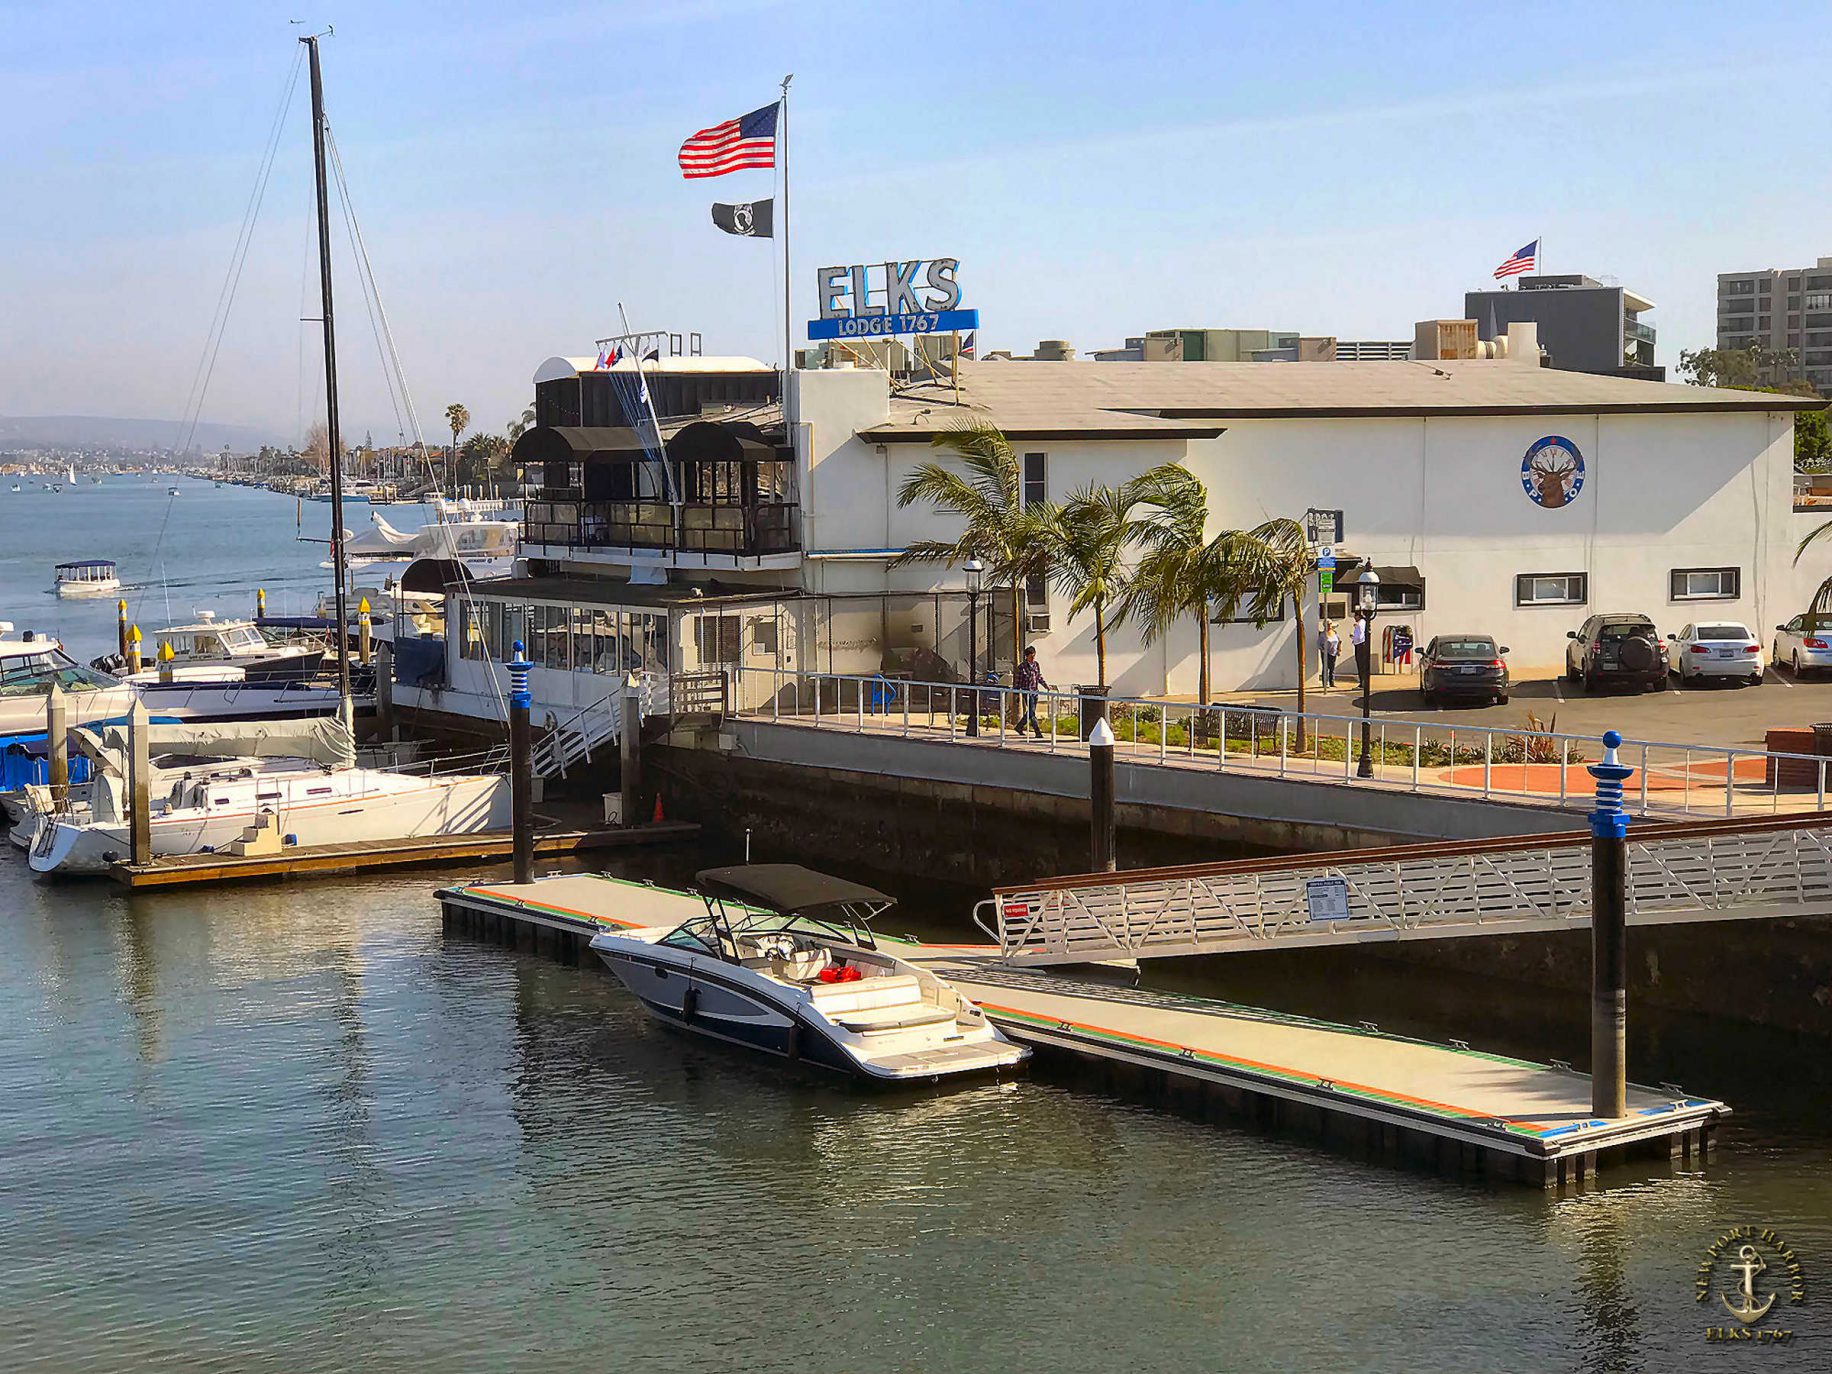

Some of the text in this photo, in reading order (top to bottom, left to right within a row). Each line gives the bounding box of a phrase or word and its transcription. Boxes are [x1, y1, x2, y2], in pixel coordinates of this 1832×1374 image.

[817, 258, 962, 320] ELKS
[838, 314, 939, 336] LODGE 1767
